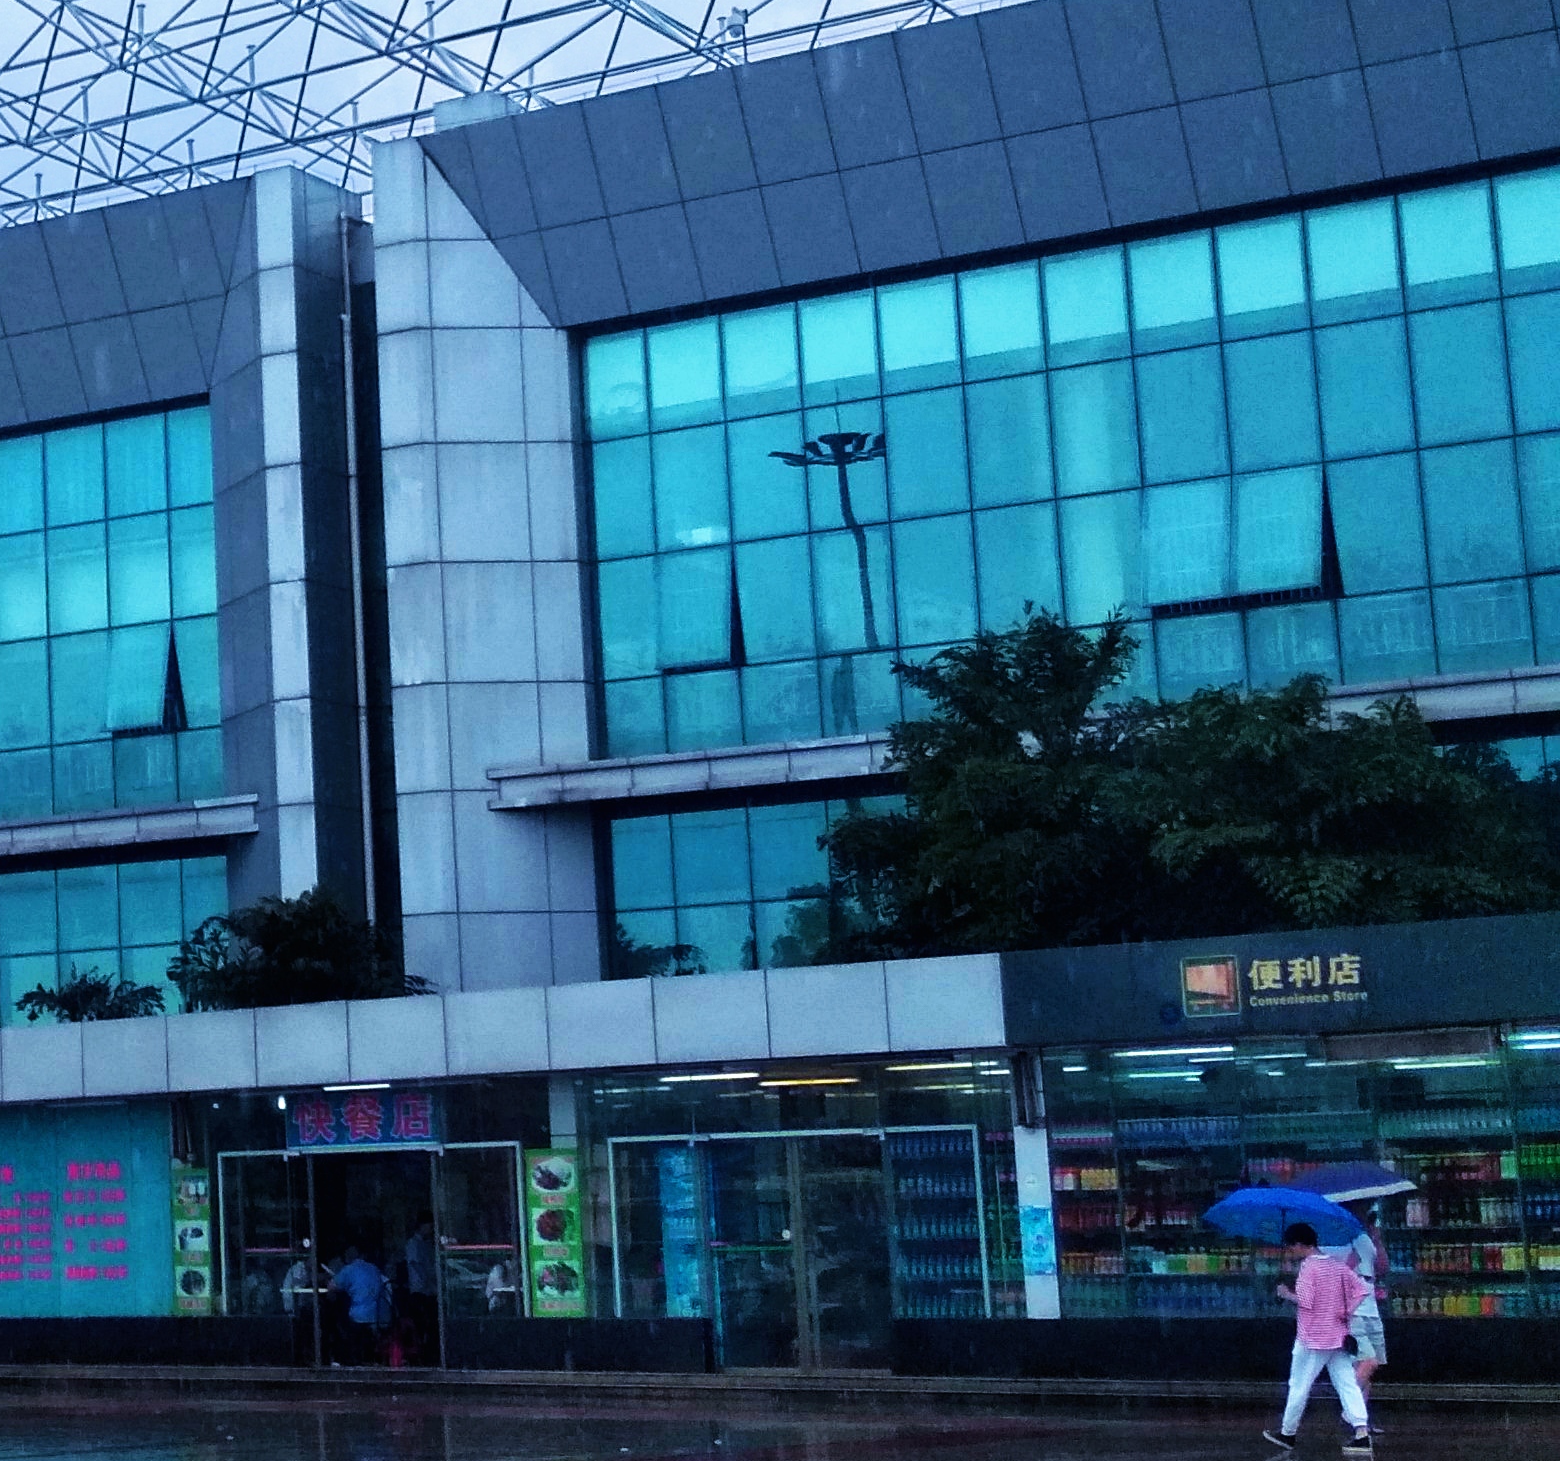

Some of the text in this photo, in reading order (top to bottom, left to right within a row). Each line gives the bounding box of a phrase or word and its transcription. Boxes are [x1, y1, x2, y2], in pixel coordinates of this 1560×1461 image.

[1248, 953, 1362, 991] 便利店
[1249, 990, 1368, 1007] Convenience Store
[293, 1092, 432, 1143] 快餐店
